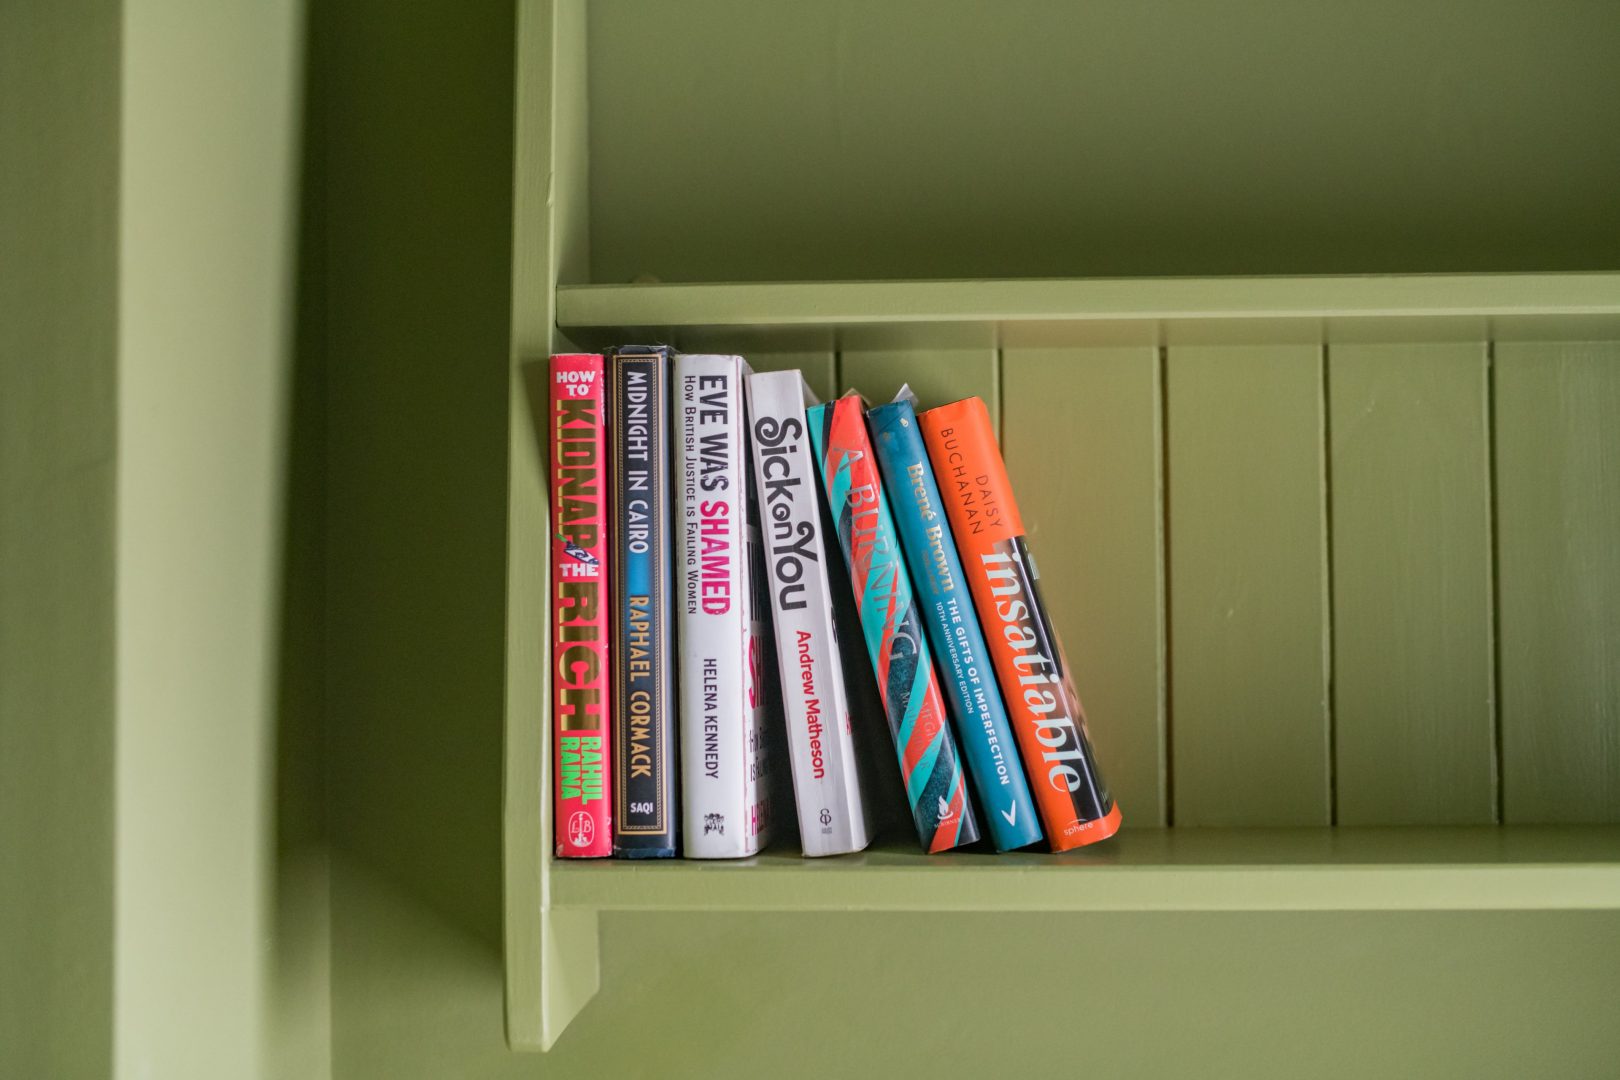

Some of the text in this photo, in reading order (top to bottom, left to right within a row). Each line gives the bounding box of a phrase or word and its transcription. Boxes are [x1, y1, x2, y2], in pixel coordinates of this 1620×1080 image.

[556, 370, 595, 383] HOW
[566, 384, 589, 396] TO
[557, 399, 599, 549] KIDNAP
[627, 371, 649, 554] MIDNIGHT IN CAIRO
[699, 375, 730, 615] EVE WAS SHAMED
[755, 416, 818, 611] Sick on You
[941, 428, 984, 535] BUCHANAN
[975, 475, 1003, 527] DAISY
[560, 563, 599, 577] THE
[833, 448, 918, 661] A BURNING
[907, 461, 937, 521] Brené
[926, 524, 954, 592] Brown
[559, 582, 600, 731] RICH
[630, 596, 651, 778] RAPHAEL CORMACK
[704, 658, 719, 779] HELENA KENNEDY
[796, 630, 825, 779] Andrew Matheson
[935, 602, 974, 714] 10TH ANNIVERSARY EDITION
[947, 597, 1010, 785] THE GIFTS OF IMPERFECTION
[980, 552, 1081, 792] insatiable
[560, 737, 581, 800] RAINA
[581, 737, 603, 805] RAHUL
[630, 802, 654, 814] SAQI
[1063, 822, 1094, 836] sphere
